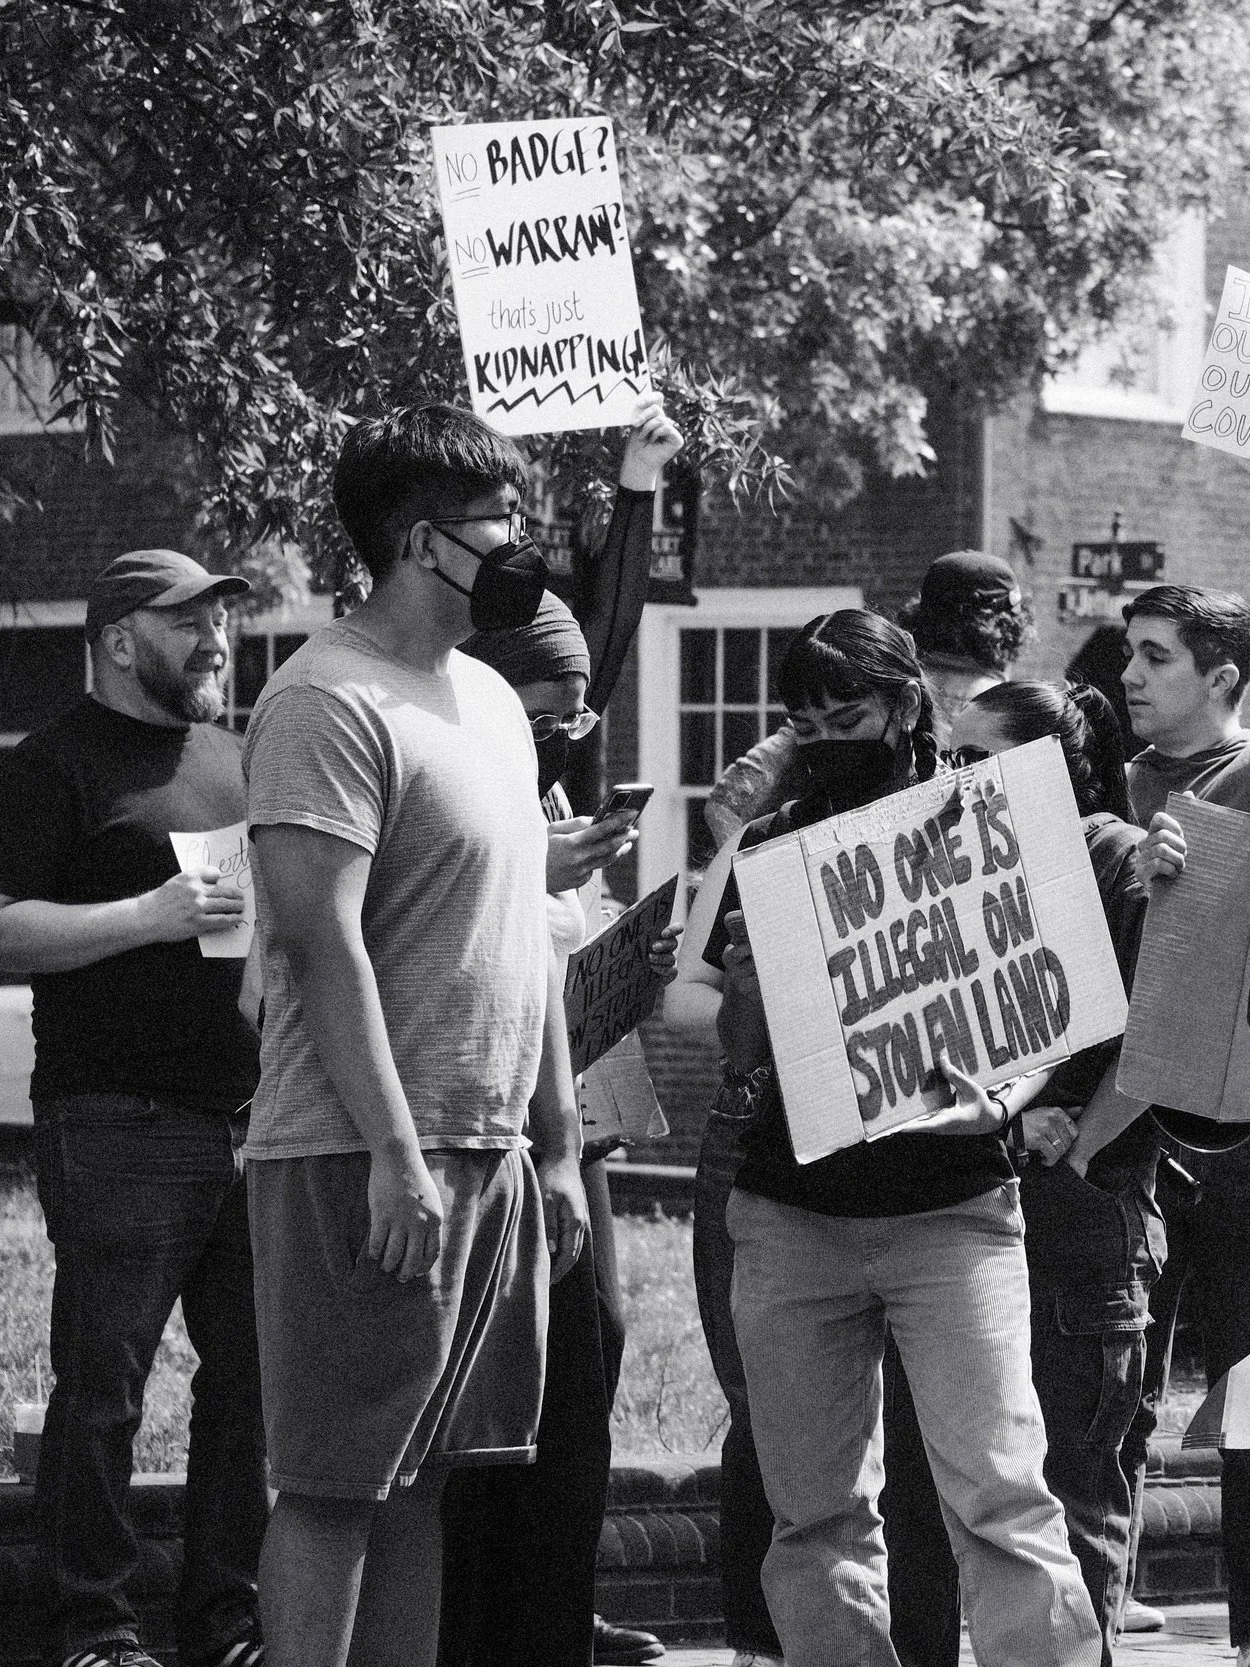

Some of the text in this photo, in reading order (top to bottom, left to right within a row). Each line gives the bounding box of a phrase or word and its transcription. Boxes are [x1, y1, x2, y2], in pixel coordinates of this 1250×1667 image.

[445, 126, 610, 187] NO BADGE?
[454, 202, 626, 269] NO WARRANT?
[487, 290, 585, 335] that's just
[473, 328, 648, 394] KIDNAPPING!
[819, 792, 1021, 940] NO ONE IS
[572, 945, 605, 995] NO
[609, 908, 647, 959] ONE
[827, 874, 1036, 1027] ILLEGAL ON
[845, 945, 1071, 1122] STOLEN LAND
